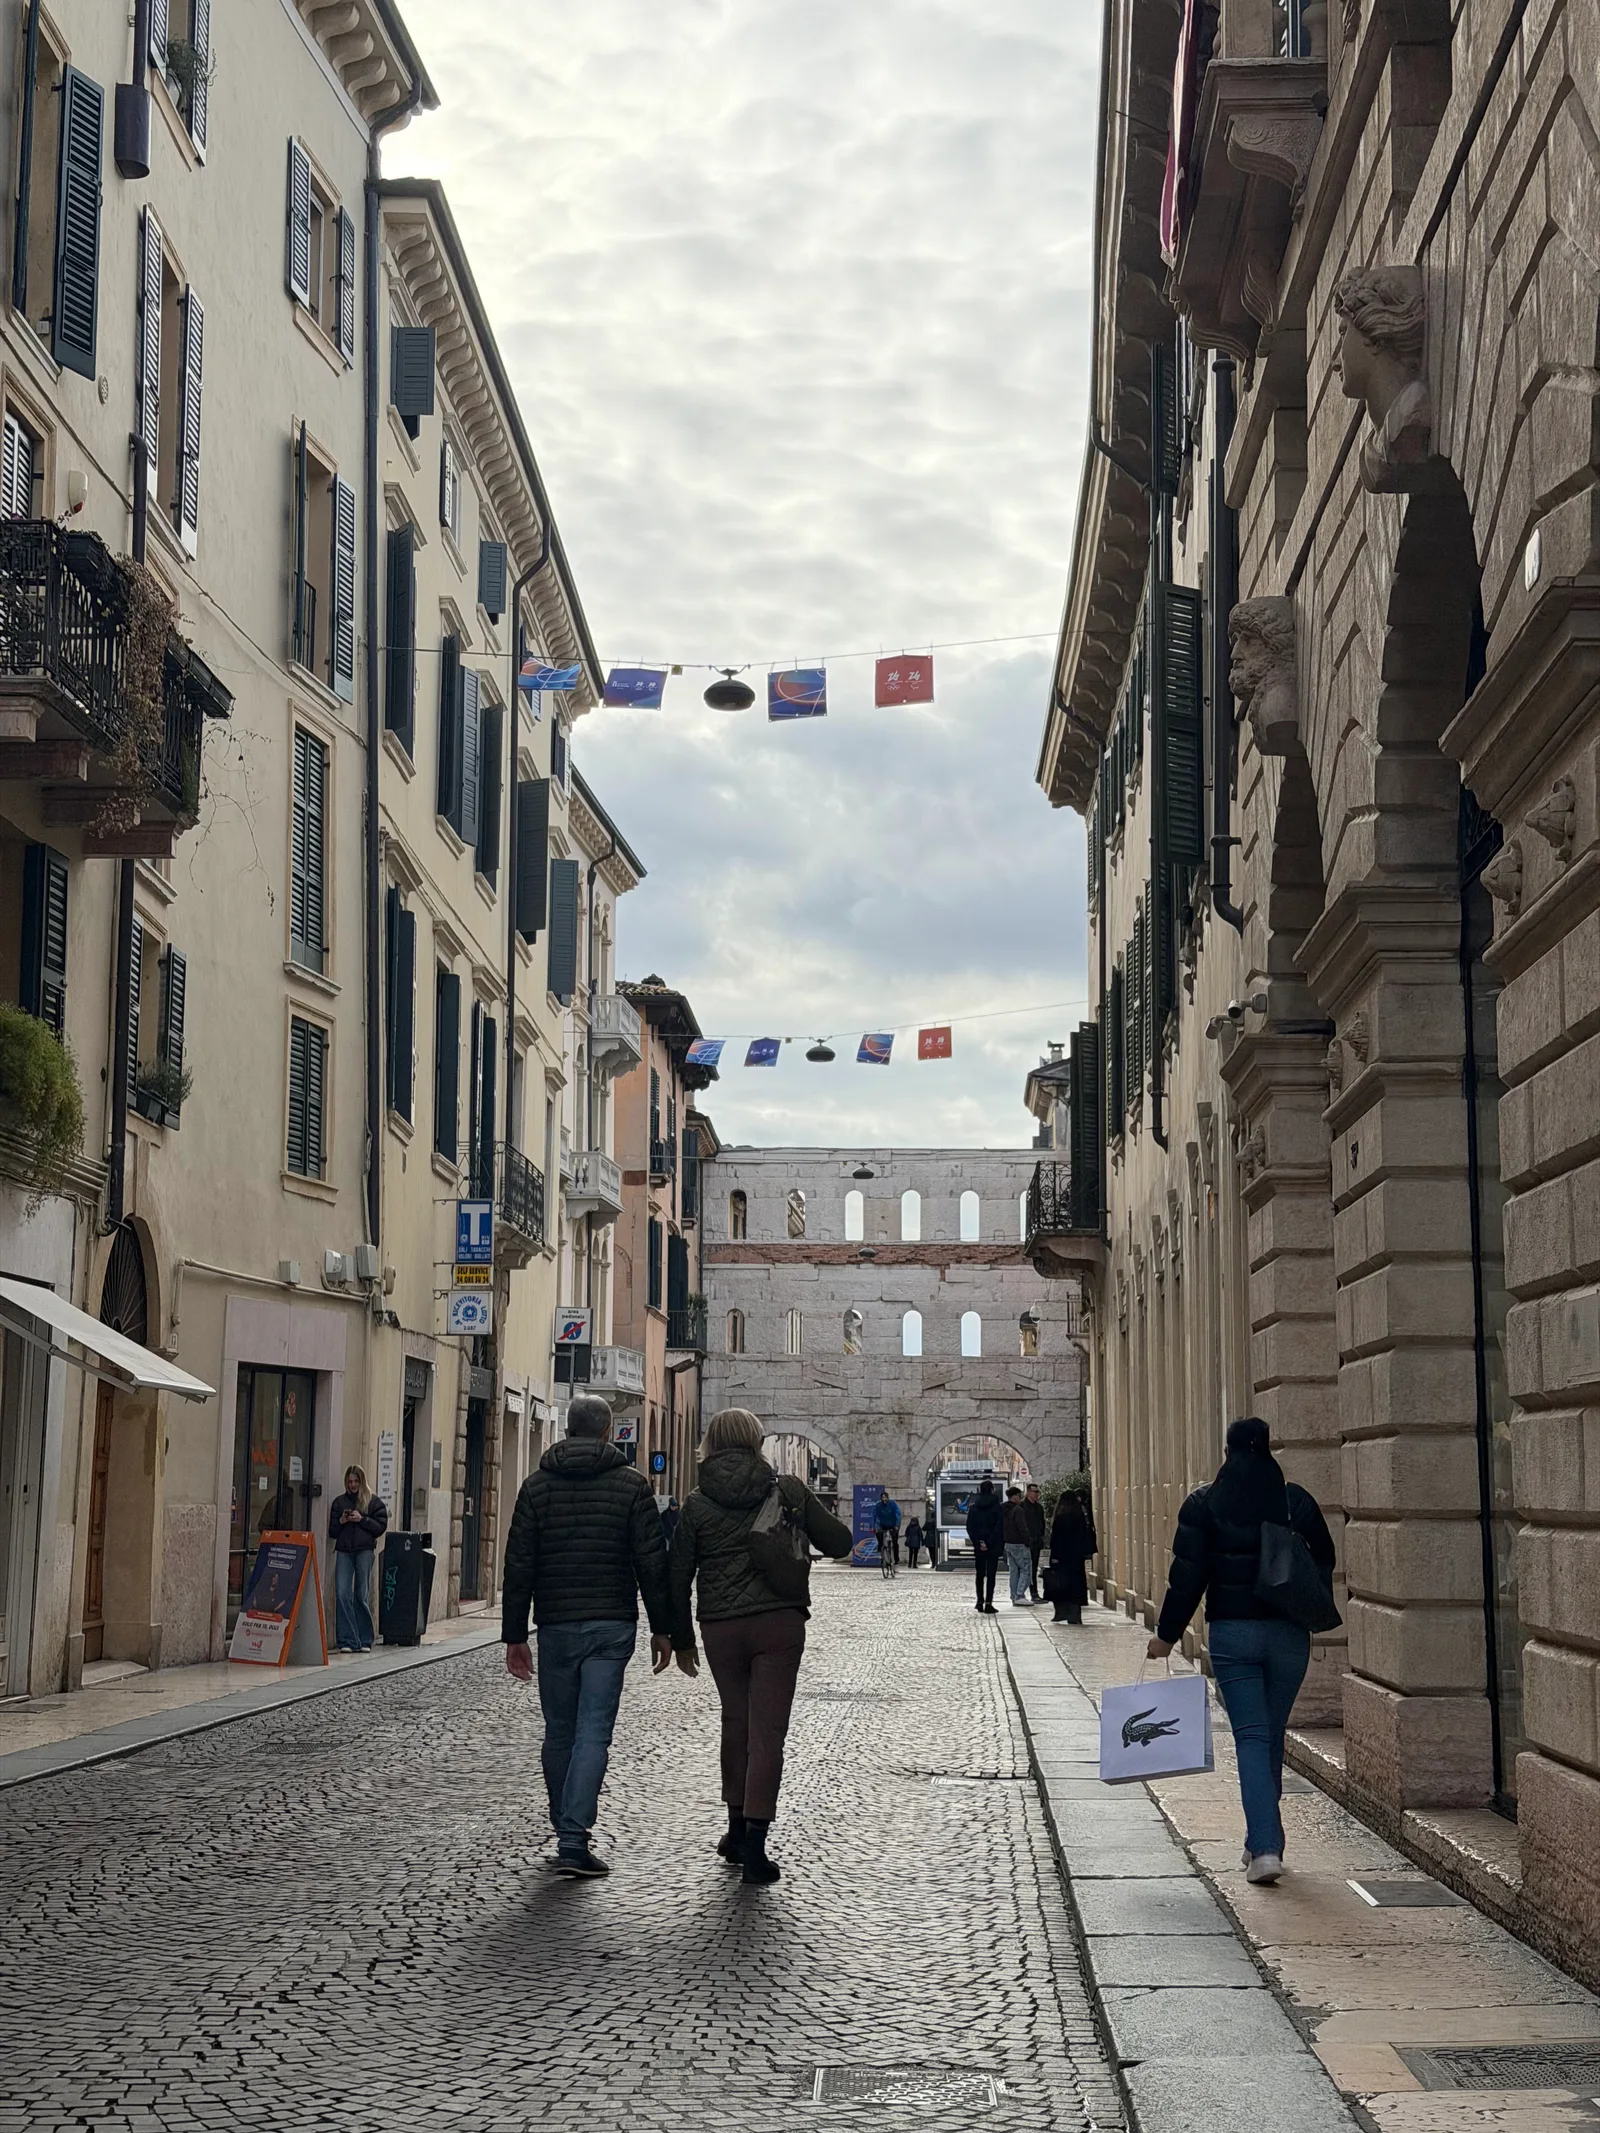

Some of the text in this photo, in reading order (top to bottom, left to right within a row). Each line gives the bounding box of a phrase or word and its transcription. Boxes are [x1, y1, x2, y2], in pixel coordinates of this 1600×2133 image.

[461, 1204, 490, 1245] T
[457, 1266, 489, 1275] SELF SERVICE
[456, 1276, 489, 1284] 24 ORE SU 24
[452, 1296, 482, 1317] RICEVITORIA
[479, 1305, 488, 1324] LOTTO
